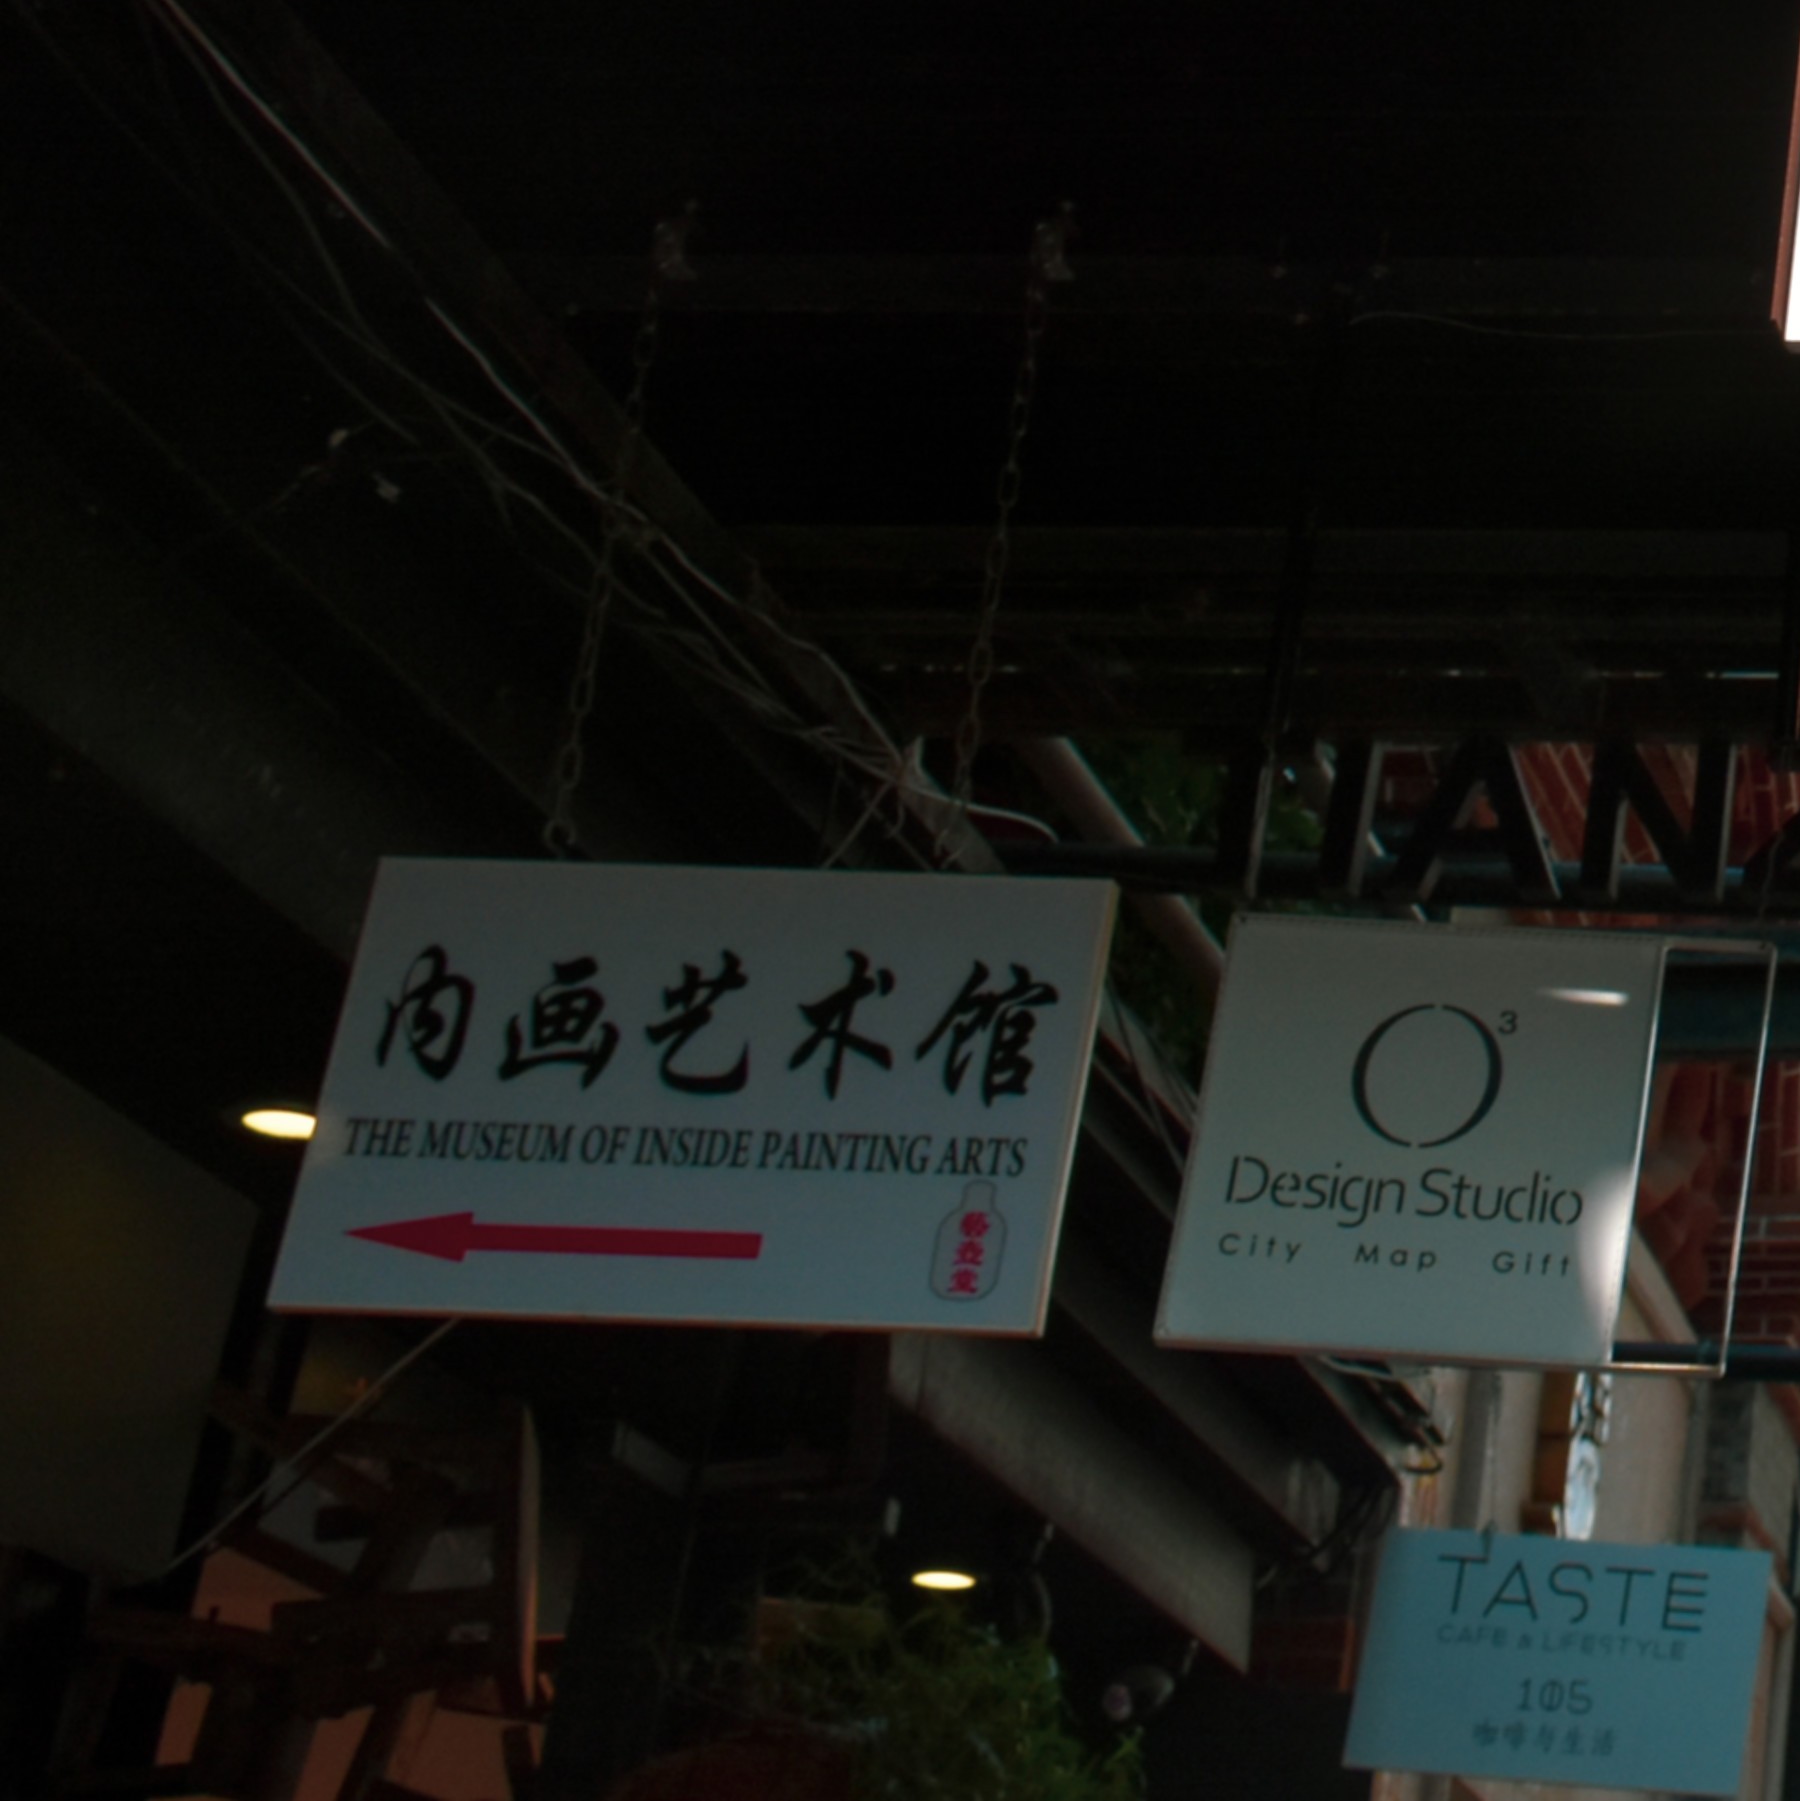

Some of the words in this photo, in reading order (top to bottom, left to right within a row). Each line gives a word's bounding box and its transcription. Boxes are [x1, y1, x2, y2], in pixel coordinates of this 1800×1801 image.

[375, 944, 1061, 1110] 内画艺术馆
[344, 1116, 412, 1160] THE
[416, 1119, 576, 1165] MUSEUM
[580, 1123, 632, 1166] OF
[632, 1126, 754, 1171] INSIDE
[756, 1130, 934, 1176] PAINTING
[934, 1135, 1029, 1179] ARTS
[1224, 1154, 1407, 1230] Design
[1416, 1167, 1584, 1228] Studio
[1217, 1232, 1303, 1265] City
[1354, 1244, 1439, 1275] Map
[1491, 1251, 1573, 1279] Gift
[1437, 1553, 1710, 1633] TASTE
